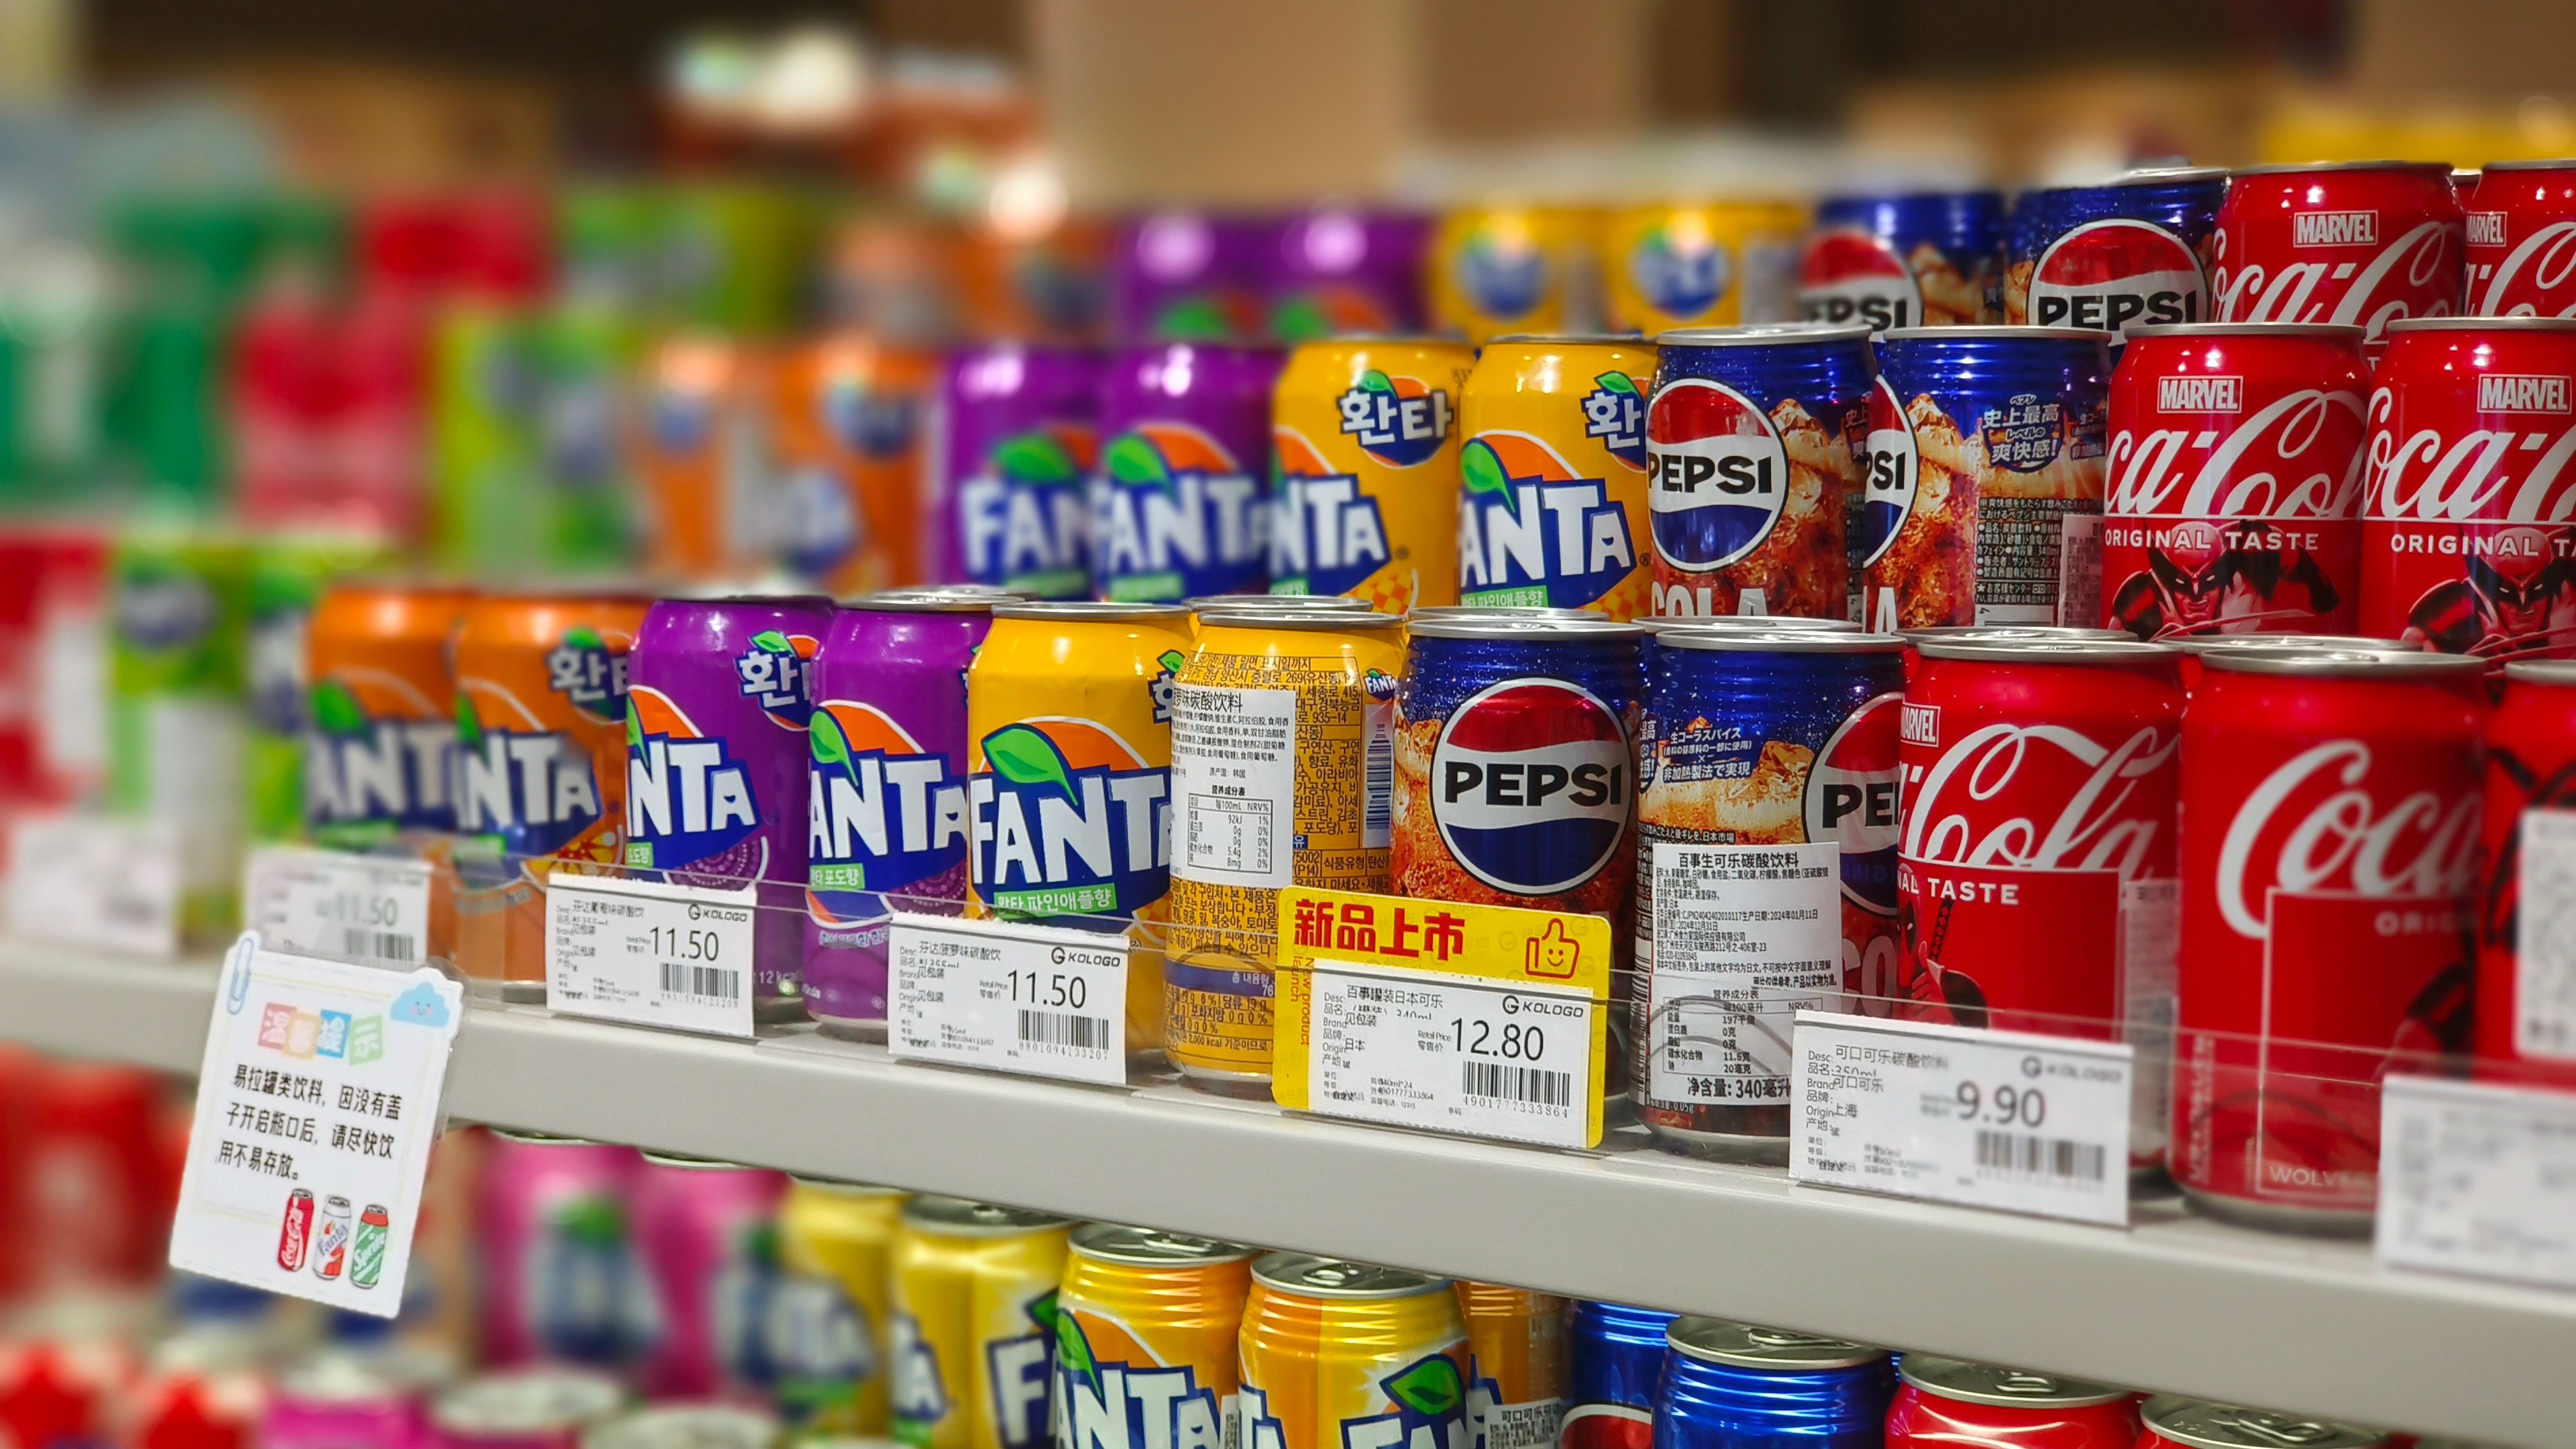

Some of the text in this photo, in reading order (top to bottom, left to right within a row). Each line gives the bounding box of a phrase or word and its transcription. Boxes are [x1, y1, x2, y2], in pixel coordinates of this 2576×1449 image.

[2297, 215, 2375, 243] MARVEL
[2038, 291, 2196, 330] PEPSI
[2161, 380, 2239, 410] MARVEL
[2480, 378, 2567, 410] MARVEL
[1341, 390, 1453, 445] 환타
[1982, 404, 2060, 429] 史上最高
[2005, 427, 2046, 441] レベルの
[1991, 440, 2058, 464] 爽快感!
[1648, 454, 1772, 494] PEPSI
[2106, 529, 2319, 551] ORIGINAL TASTE
[2391, 534, 2539, 556] ORIGINAL
[739, 650, 810, 708] 환
[1313, 711, 1347, 724] 935-14
[1670, 727, 1742, 744] 生コーラスパイス
[1299, 740, 1336, 755] 구연산,
[1316, 768, 1358, 781] 아라비아
[1663, 761, 1751, 781] 非加熱製法で実現
[455, 732, 599, 834] NTA
[627, 739, 756, 838] NTA
[1445, 760, 1622, 807] PEPSI
[1247, 802, 1269, 812] NRV%
[1822, 783, 1898, 829] PE
[1899, 724, 2175, 887] -Cola
[970, 774, 1171, 885] FANT
[1257, 827, 1269, 836] 0%
[1259, 816, 1269, 826] 1%
[1257, 838, 1269, 847] 0%
[1257, 848, 1268, 858] 2%
[1257, 859, 1268, 869] 0%
[1324, 856, 1365, 871] 식품유형
[1368, 856, 1388, 870] 탄산
[1678, 852, 1799, 869] 百事生可乐碳酸饮料
[1027, 888, 1112, 912] 파인애플향
[1928, 877, 2020, 905] TASTE
[703, 910, 748, 923] KOLOGO
[1294, 898, 1466, 962] 新品上市
[650, 926, 719, 961] 11.50
[1068, 952, 1121, 968] KOLOGO
[1008, 969, 1086, 1009] 11.50
[1712, 988, 1759, 1000] 营养成分表
[1300, 992, 1311, 1046] product
[1522, 1001, 1584, 1018] KOLOGO
[1345, 1038, 1365, 1052] 日本
[1451, 1017, 1544, 1061] 12.80
[1807, 1044, 1950, 1071] Desc: 可口可乐碳酸饮料
[1807, 1061, 1834, 1077] 品名:
[1832, 1073, 1884, 1093] 可口可乐
[1462, 1095, 1568, 1119] 4901777333864
[1807, 1089, 1834, 1104] 品牌:
[1956, 1080, 2046, 1128] 9.90
[1833, 1103, 1858, 1118] 上海
[1806, 1117, 1828, 1131] 产地
